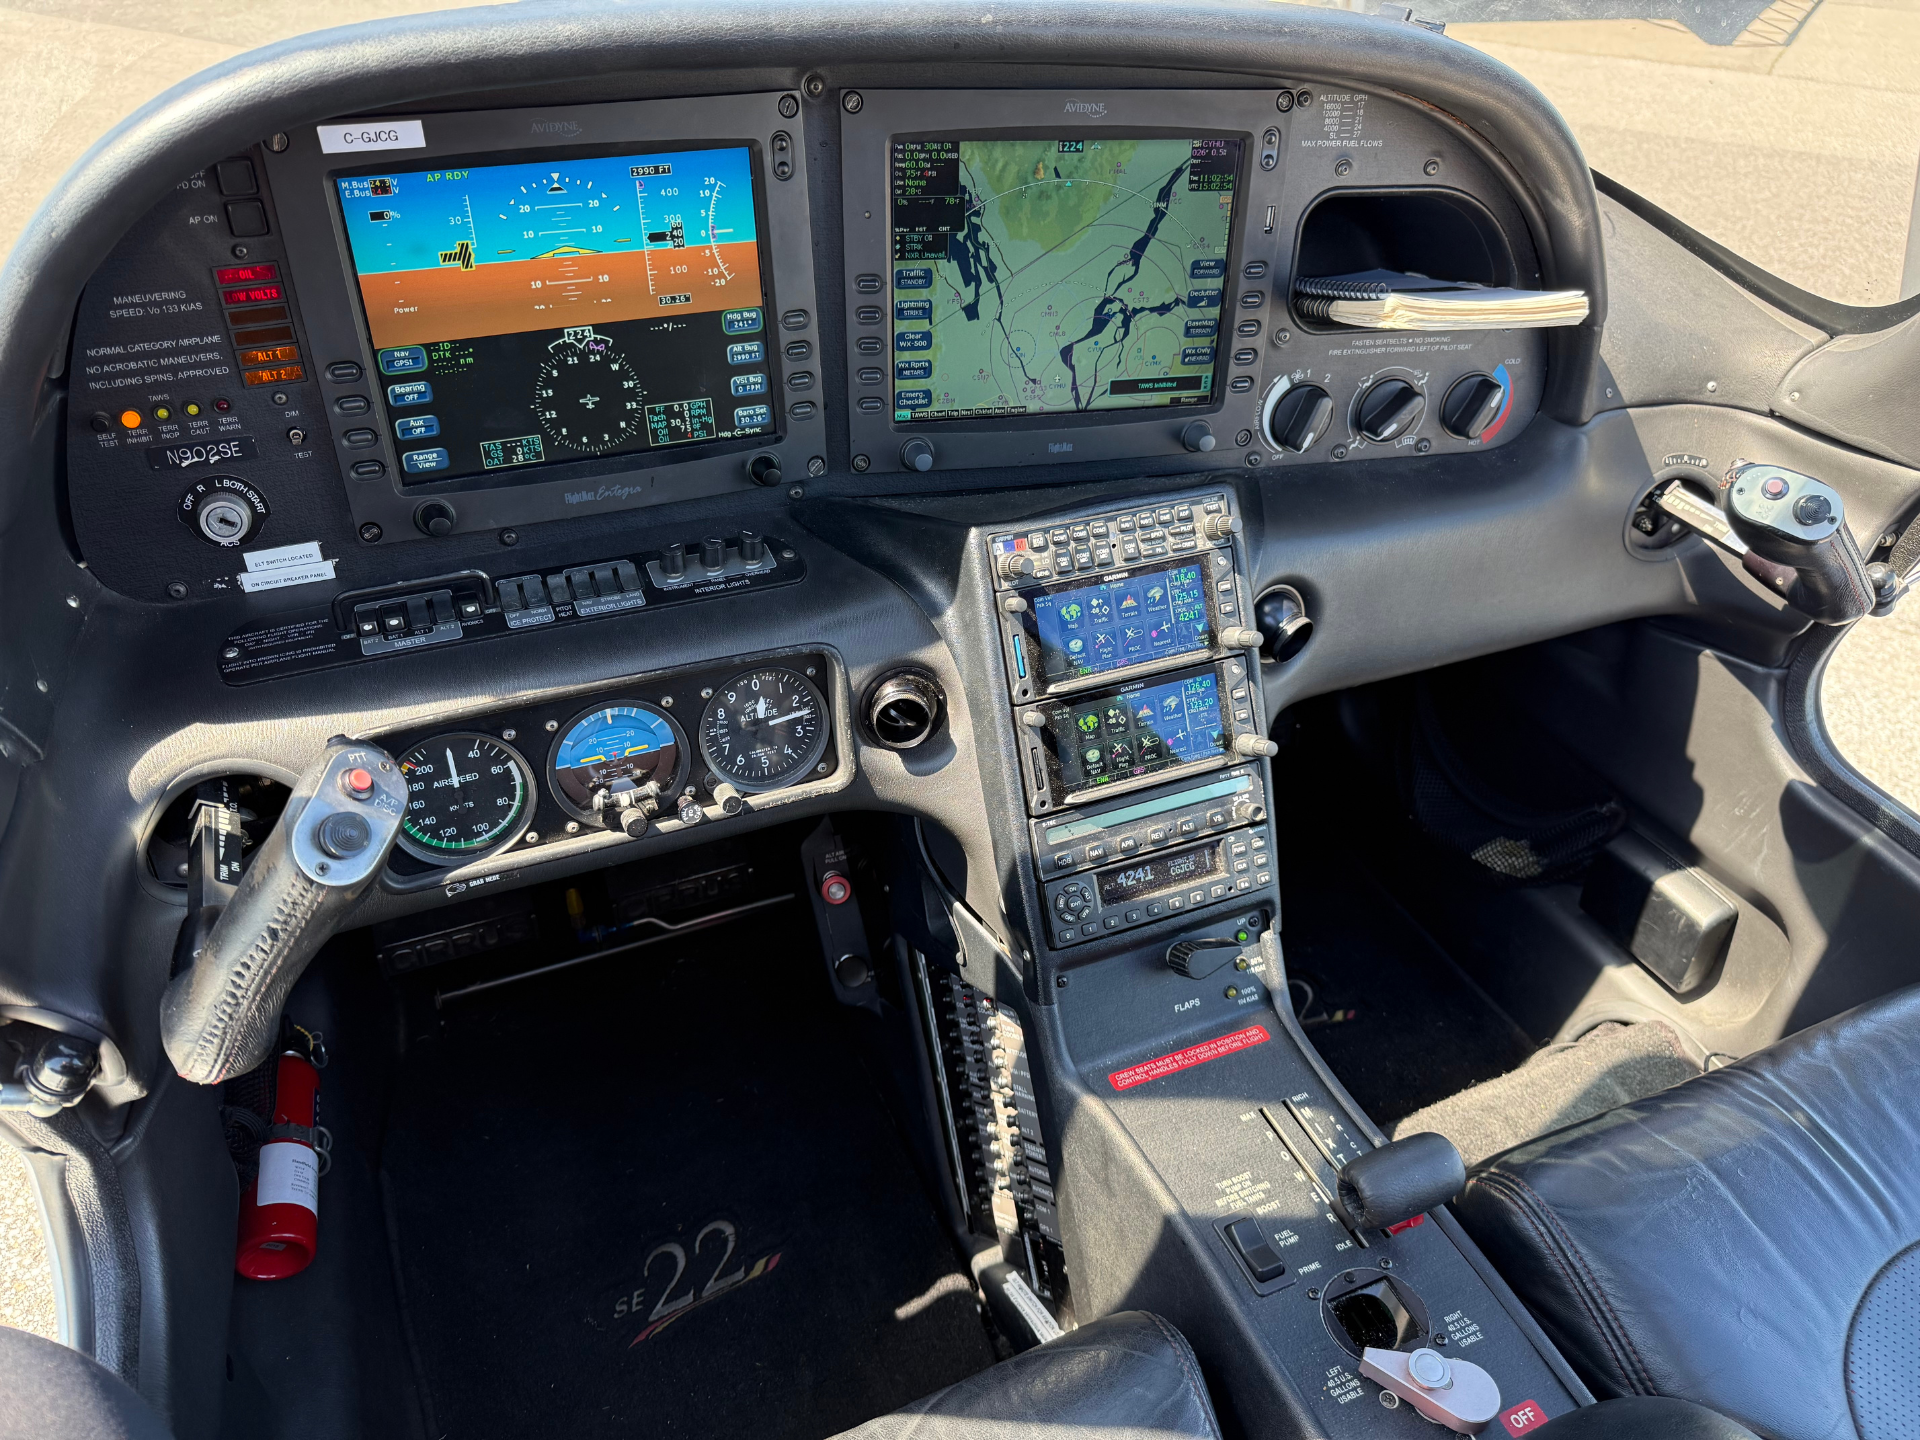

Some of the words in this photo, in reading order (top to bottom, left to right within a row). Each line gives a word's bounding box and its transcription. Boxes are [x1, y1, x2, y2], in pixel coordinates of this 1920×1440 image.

[1064, 102, 1105, 113] AVIDYNE
[531, 121, 578, 133] AVIDYNE
[343, 130, 399, 144] C-GJCG
[1064, 142, 1083, 151] 224
[632, 167, 654, 175] 2990
[659, 165, 670, 173] FT
[426, 174, 441, 182] AP
[446, 171, 469, 180] RDY
[1200, 174, 1233, 182] 11:02:54
[661, 188, 679, 196] 400
[189, 216, 200, 224] AP
[203, 215, 217, 223] ON
[239, 269, 255, 279] OIL
[670, 266, 687, 274] 100
[113, 291, 186, 305] MANEUVERING
[227, 290, 247, 302] LOW
[249, 289, 278, 299] VOLTS
[110, 307, 146, 318] SPEED:
[163, 305, 178, 313] 133
[180, 303, 202, 311] KIAS
[394, 306, 418, 314] Power
[569, 330, 590, 339] 224
[86, 345, 127, 357] NORMAL
[127, 340, 176, 353] CATEGORY
[178, 335, 222, 347] AIRPLANE
[258, 352, 273, 360] ALT
[275, 351, 281, 359] 1
[86, 366, 101, 375] NO
[103, 359, 158, 372] ACROBATIC
[394, 359, 413, 367] GPS1
[89, 377, 143, 390] INCLUDING
[178, 367, 229, 379] APPROVED
[262, 371, 277, 380] ALT
[278, 370, 286, 378] 2
[395, 384, 425, 393] Bearing
[148, 394, 169, 402] TAWS
[158, 425, 179, 433] TERR
[190, 427, 210, 435] CAUT
[218, 423, 241, 431] WARN
[412, 427, 425, 435] OFF
[97, 433, 116, 441] SELF
[127, 435, 153, 444] INHIBIT
[100, 440, 119, 448] TEST
[166, 442, 242, 467] N902SE
[413, 452, 438, 461] Range
[183, 494, 195, 510] OFF
[223, 480, 247, 494] BOTH
[247, 487, 265, 514] START
[596, 485, 641, 500] Entegra
[1104, 572, 1128, 582] GARMIN
[1172, 571, 1195, 581] 118.40
[695, 584, 725, 594] INTERIOR
[726, 579, 750, 590] LIGHTS
[1174, 590, 1198, 600] 125.15
[580, 602, 615, 614] EXTERIOR
[617, 599, 643, 609] LIGHTS
[522, 614, 552, 625] PROTECT
[558, 610, 573, 618] HEAT
[395, 637, 426, 648] MASTER
[752, 680, 759, 690] 0
[1120, 683, 1144, 692] GARMIN
[728, 692, 736, 703] 9
[792, 695, 799, 706] 2
[718, 708, 725, 719] 8
[796, 726, 803, 736] 3
[468, 750, 480, 758] 40
[722, 744, 730, 755] 7
[784, 745, 792, 754] 4
[348, 752, 366, 762] PTT
[736, 754, 744, 765] 6
[761, 757, 769, 767] 5
[415, 765, 433, 775] 200
[491, 765, 504, 774] 60
[408, 782, 424, 792] 180
[379, 793, 399, 806] A/P
[409, 800, 425, 810] 160
[497, 797, 508, 806] 80
[374, 799, 396, 816] DISC
[419, 816, 436, 826] 140
[440, 827, 456, 837] 120
[472, 822, 489, 833] 100
[1182, 823, 1194, 831] ALT
[1151, 832, 1163, 840] REV
[1058, 857, 1071, 866] HDG
[1171, 862, 1195, 876] CGJCG
[1117, 866, 1154, 886] 4241
[1174, 999, 1201, 1013] FLAPS
[1115, 1071, 1135, 1081] CREW
[1136, 1063, 1155, 1074] SEATS
[1157, 1057, 1173, 1067] MUST
[1184, 1045, 1209, 1057] LOCKED
[1217, 1034, 1245, 1048] POSITION
[1246, 1029, 1259, 1038] AND
[1118, 1074, 1148, 1086] CONTROL
[1149, 1062, 1178, 1076] HANDLES
[1179, 1056, 1196, 1066] FULLY
[1198, 1050, 1218, 1059] DOWN
[1219, 1041, 1243, 1053] BEFORE
[1243, 1034, 1264, 1045] FLIGHT
[1292, 1092, 1308, 1102] RICH
[1257, 1200, 1281, 1216] BOOST
[1275, 1230, 1294, 1242] FUEL
[1279, 1234, 1299, 1247] PUMP
[1335, 1240, 1353, 1252] IDLE
[613, 1289, 645, 1319] SE
[643, 1219, 746, 1322] 22
[1299, 1261, 1322, 1276] PRIME
[1444, 1311, 1463, 1323] RIGHT
[1448, 1322, 1461, 1331] 40.5
[1460, 1318, 1472, 1326] U.S.
[1451, 1323, 1479, 1341] GALLONS
[1459, 1332, 1484, 1348] USABLE
[1326, 1366, 1342, 1377] LEFT
[1328, 1378, 1340, 1388] 40.5
[1340, 1373, 1353, 1382] U.S.
[1331, 1379, 1360, 1397] GALLONS
[1338, 1388, 1364, 1404] USABLE
[1510, 1408, 1535, 1428] OFF
